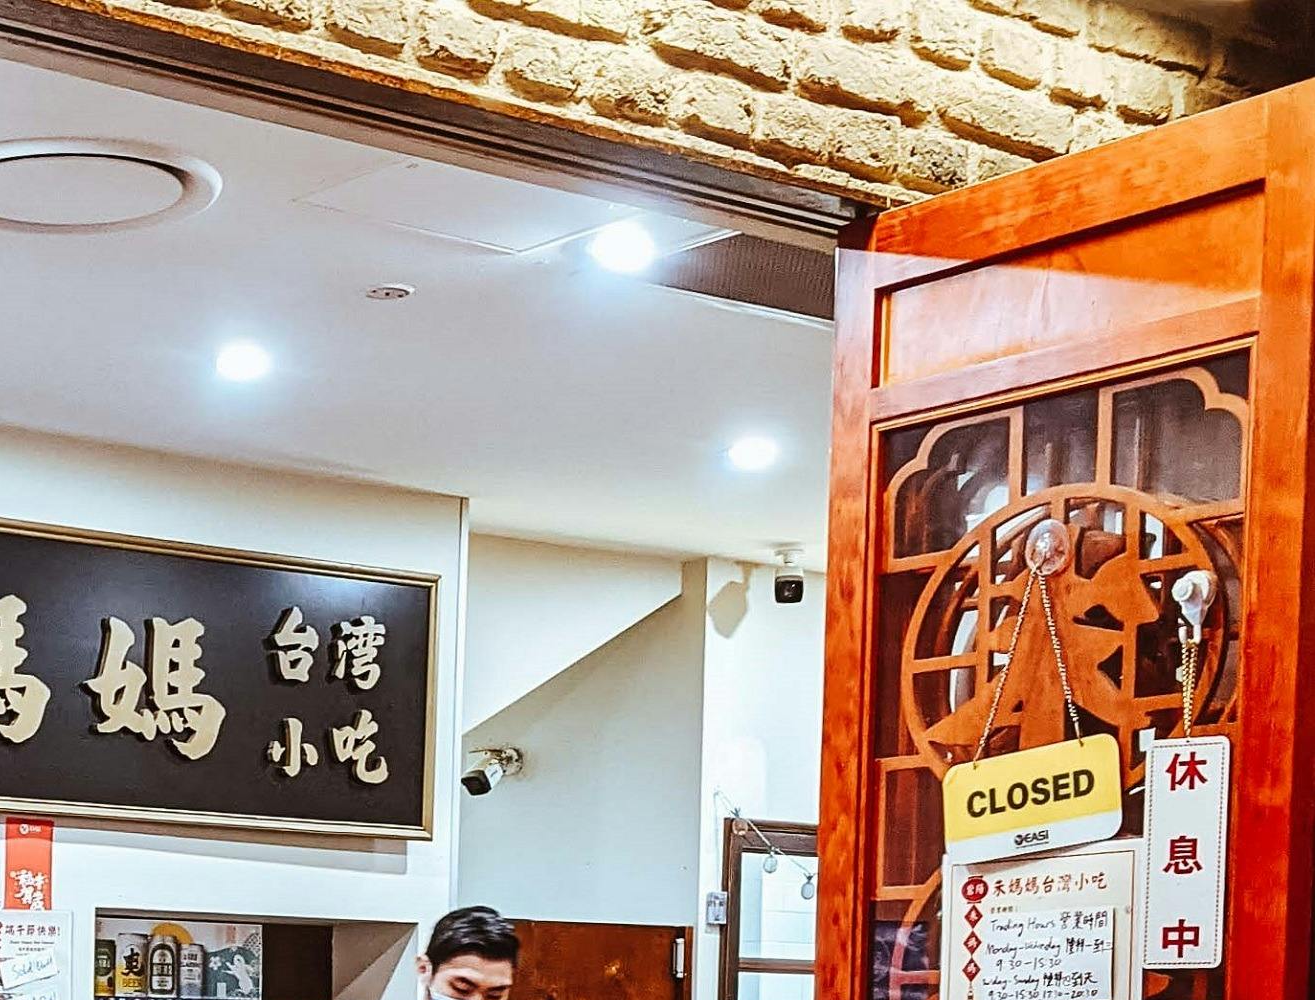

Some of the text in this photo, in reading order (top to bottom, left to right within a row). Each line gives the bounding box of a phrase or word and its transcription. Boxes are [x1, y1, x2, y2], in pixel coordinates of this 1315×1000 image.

[268, 710, 389, 784] 小吃
[967, 769, 1095, 818] CLOSED
[1025, 830, 1049, 843] EASI
[1162, 751, 1208, 958] 休息中
[991, 920, 1023, 937] Trading
[1027, 917, 1055, 929] Hours
